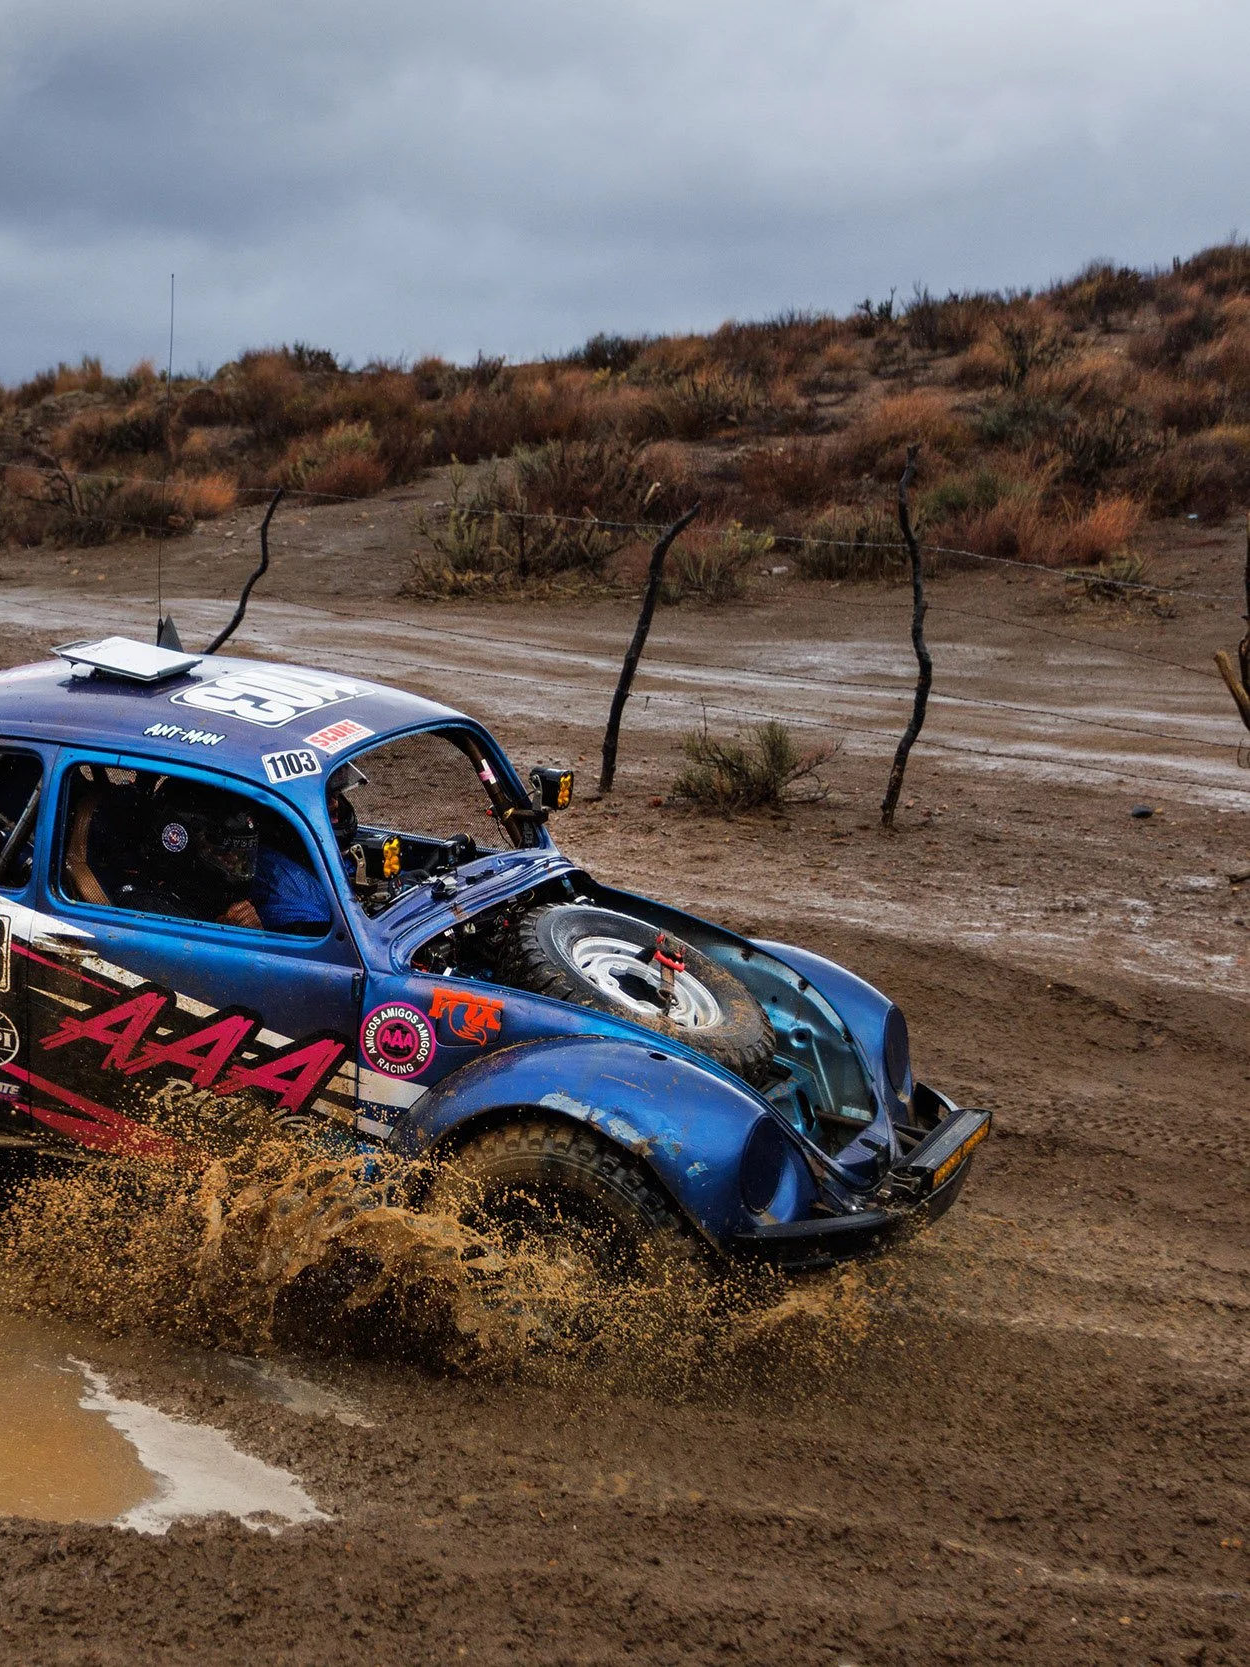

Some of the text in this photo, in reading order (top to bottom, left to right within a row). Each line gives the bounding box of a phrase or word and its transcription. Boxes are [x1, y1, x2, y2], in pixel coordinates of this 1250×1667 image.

[144, 722, 225, 746] ANT-MAN
[310, 721, 362, 747] SCORE
[267, 751, 317, 779] 1103
[429, 987, 505, 1032] FOX
[365, 1007, 430, 1062] AMIGOS AMIGOS AMIGOS
[382, 1029, 413, 1049] AAA
[40, 991, 345, 1112] AAA
[376, 1057, 414, 1074] RACING
